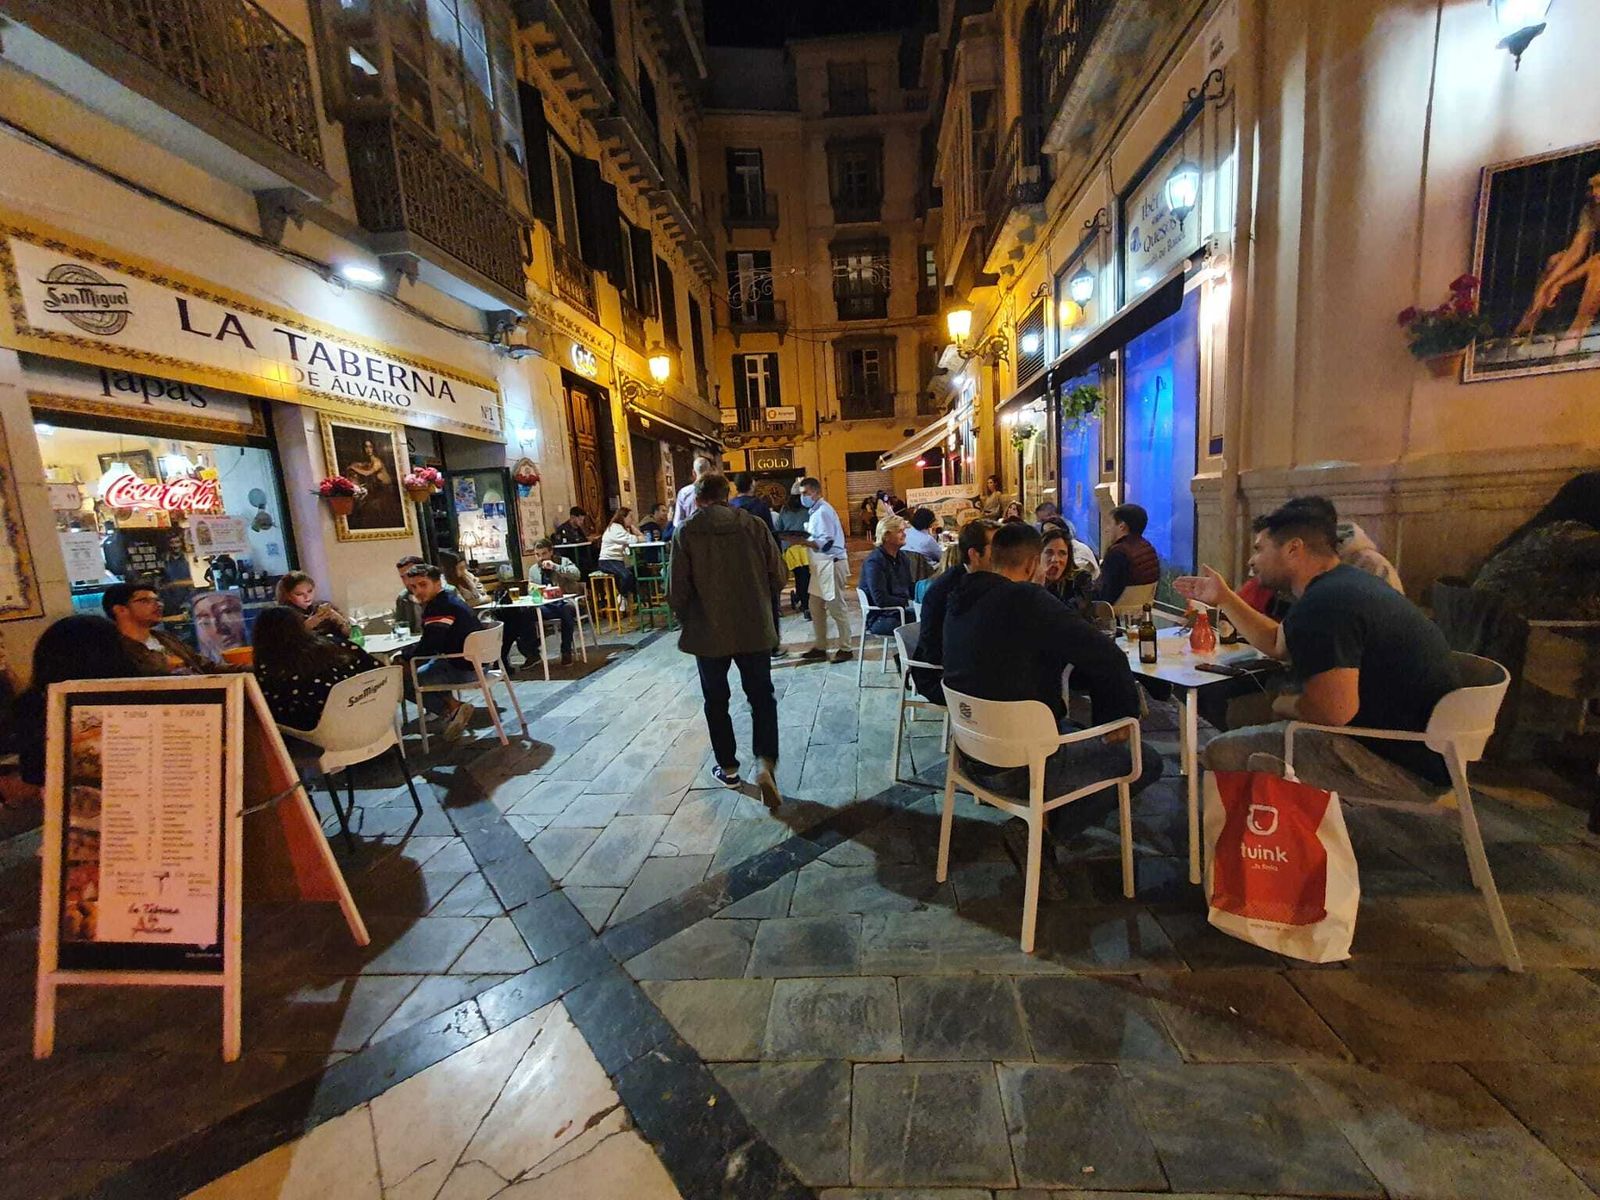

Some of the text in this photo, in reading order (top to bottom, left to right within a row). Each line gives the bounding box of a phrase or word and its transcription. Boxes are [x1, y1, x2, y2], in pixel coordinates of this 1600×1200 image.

[175, 296, 457, 404] LA TABERNA
[294, 367, 412, 408] DE ÁLVARO
[757, 458, 790, 470] GOLD
[1240, 842, 1289, 863] tuink
